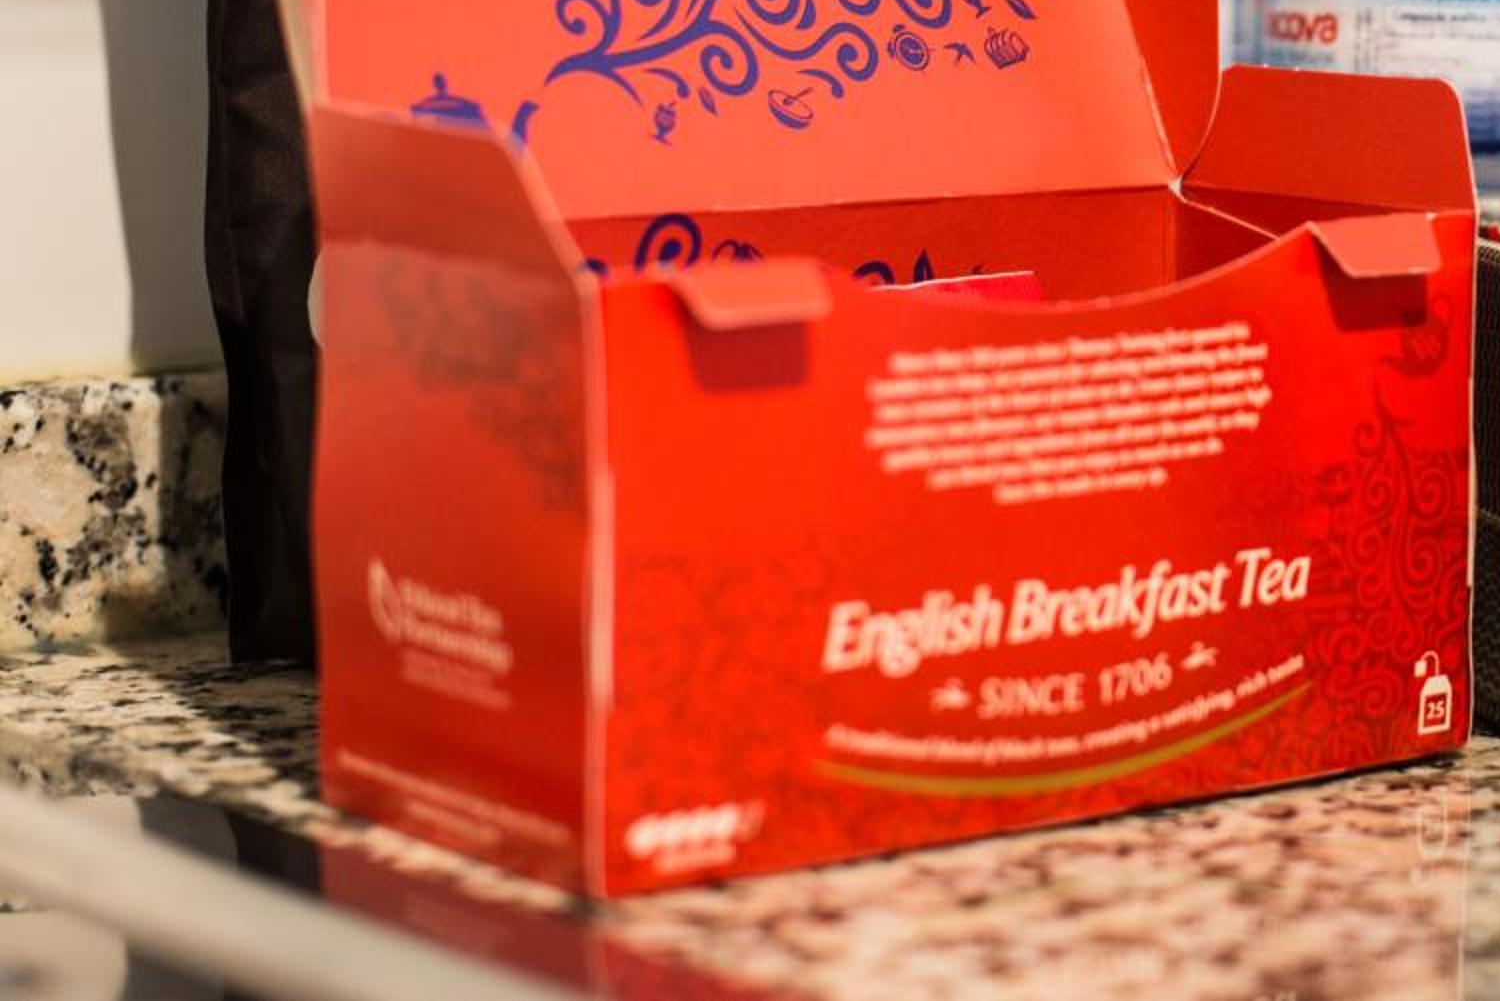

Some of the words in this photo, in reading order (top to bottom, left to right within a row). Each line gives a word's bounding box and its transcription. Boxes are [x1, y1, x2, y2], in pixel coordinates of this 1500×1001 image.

[822, 584, 1002, 678] English
[1007, 560, 1231, 645] Breakfast
[1235, 548, 1311, 608] Tea
[977, 671, 1086, 719] SINCE
[1100, 652, 1172, 705] 1706
[1427, 700, 1444, 719] 25
